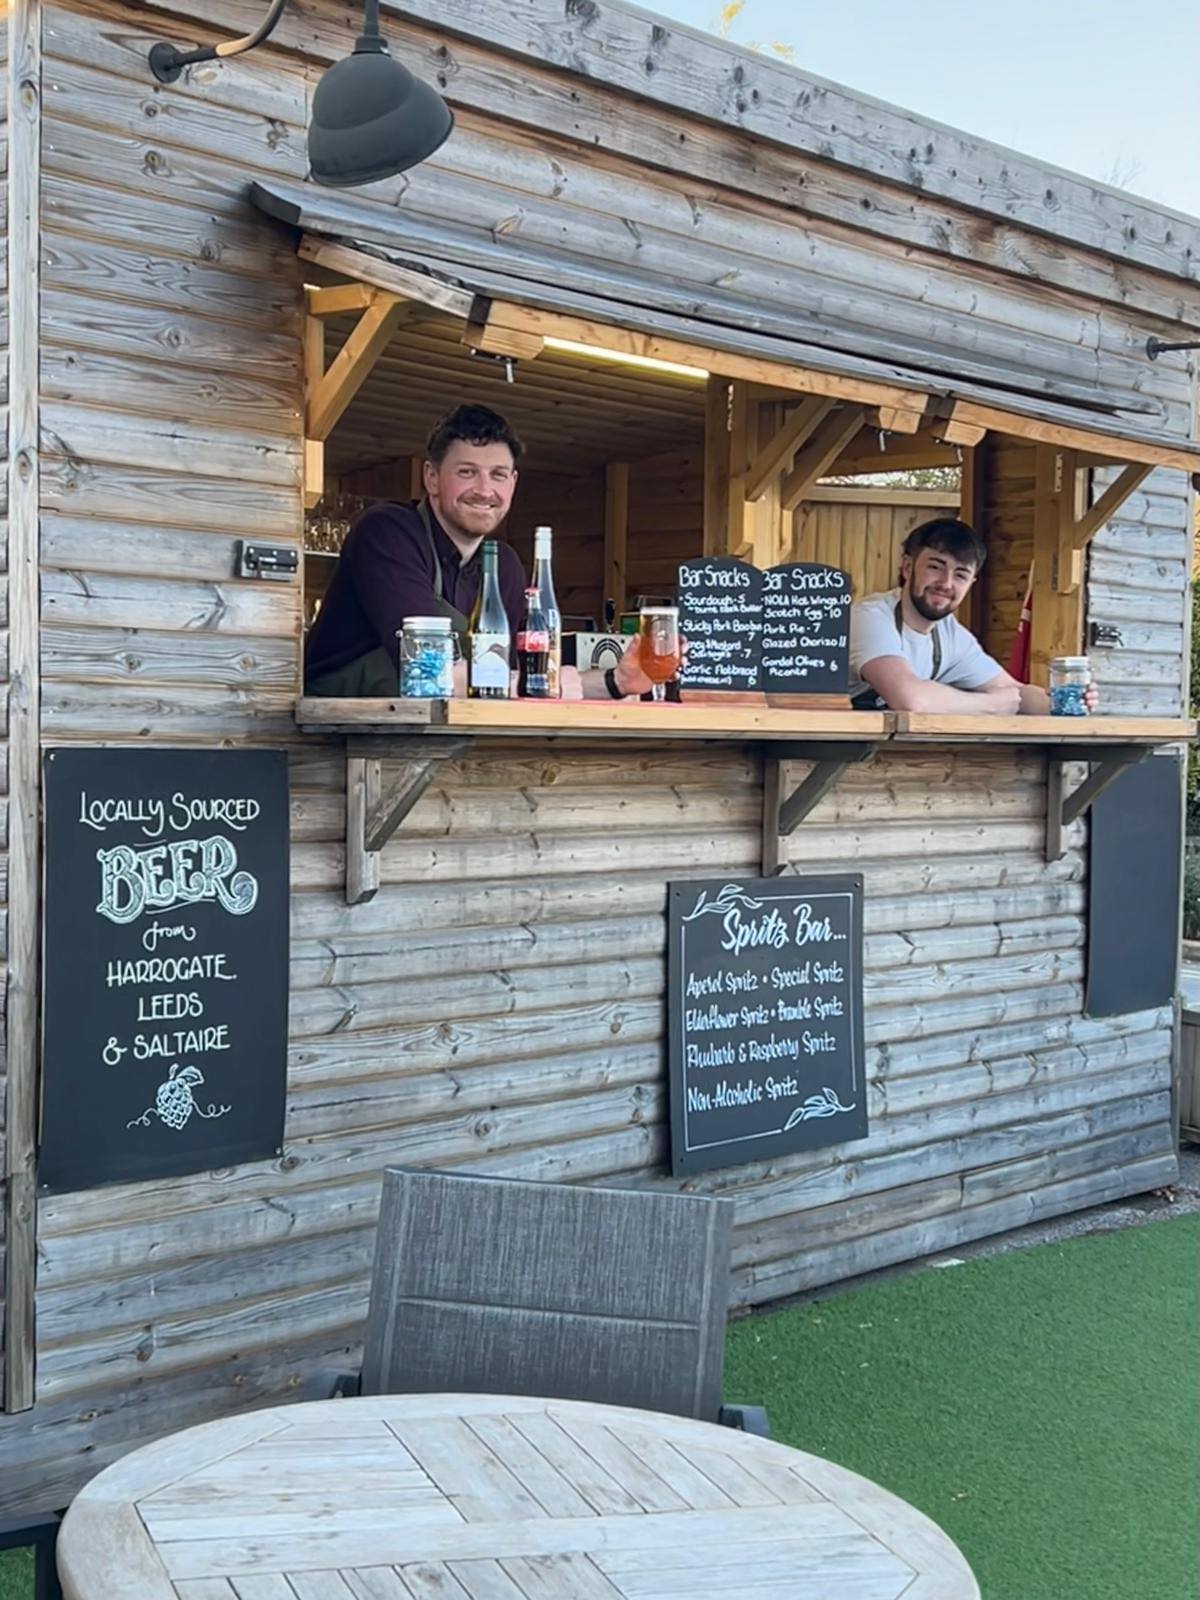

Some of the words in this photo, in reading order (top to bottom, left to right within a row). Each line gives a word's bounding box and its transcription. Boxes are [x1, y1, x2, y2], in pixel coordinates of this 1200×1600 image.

[678, 565, 704, 588] Bar
[704, 564, 751, 588] Snacks
[790, 567, 844, 591] Snacks
[684, 592, 734, 607] Sourdough
[764, 594, 790, 607] NOLA
[791, 595, 809, 606] Hot
[764, 607, 802, 619] Scotch
[804, 607, 824, 621] Egg
[829, 608, 843, 619] 10
[713, 618, 733, 632] Pork
[763, 623, 787, 635] Pork
[789, 623, 806, 634] Pie
[812, 622, 822, 633] 7
[711, 639, 742, 652] Mustard
[747, 632, 756, 642] 7
[761, 637, 798, 649] Glazed
[800, 636, 839, 648] Chorizo
[744, 648, 753, 659] 7
[683, 662, 713, 676] Garlic
[715, 664, 759, 677] Flatbread
[769, 667, 809, 678] Picante
[795, 655, 826, 668] Olives
[829, 660, 839, 673] 6
[95, 834, 259, 925] BEER
[142, 920, 197, 951] from
[721, 907, 791, 957] Spritz
[686, 969, 724, 1000] Aperol
[725, 969, 759, 995] Spritz
[771, 960, 811, 990] Special
[813, 960, 845, 985] Spritz
[136, 991, 204, 1022] LEEDS
[686, 1004, 739, 1032] Elderflower
[740, 1004, 770, 1029] Spritz
[777, 998, 813, 1022] Bramble
[814, 995, 844, 1021] Spritz
[102, 1036, 129, 1066] &
[133, 1024, 231, 1060] SALTAIRE
[686, 1042, 736, 1069] Rhubarb
[738, 1042, 748, 1063] &
[748, 1032, 800, 1062] Raspberry
[801, 1030, 837, 1057] Spritz
[688, 1079, 764, 1113] Non-Alcoholic
[765, 1075, 800, 1101] Spritz
